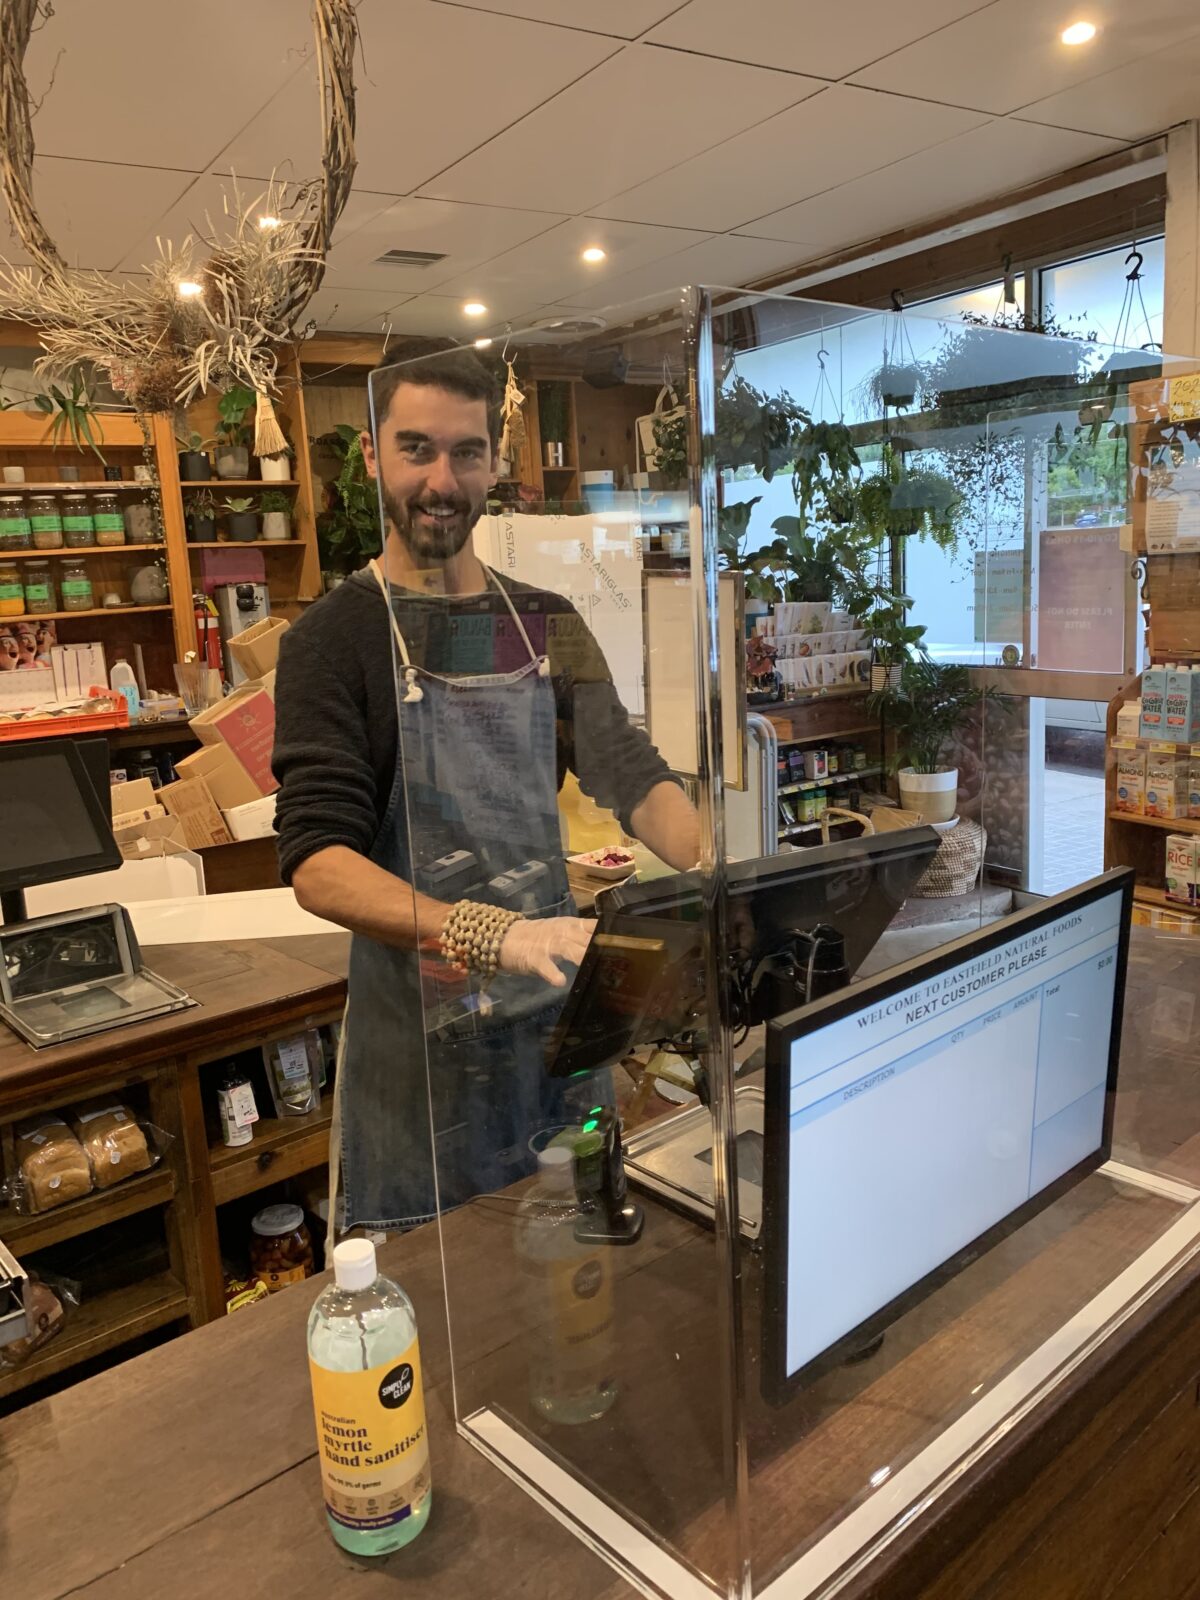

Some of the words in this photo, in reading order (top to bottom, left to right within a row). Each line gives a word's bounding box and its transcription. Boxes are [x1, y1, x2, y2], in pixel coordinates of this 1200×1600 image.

[1142, 703, 1162, 714] WATER
[1167, 706, 1187, 716] WATER
[1118, 767, 1144, 777] ALMOND
[1168, 851, 1193, 867] RICE
[857, 991, 922, 1029] WELCOME
[924, 983, 941, 998] TO
[943, 951, 1003, 990] EASTFIELD
[1004, 932, 1049, 964] NATURAL
[1052, 914, 1083, 939] FOODS
[905, 998, 939, 1024] NEXT
[941, 965, 1006, 1007] CUSTOMER
[1008, 945, 1049, 975] PLEASE
[843, 1065, 896, 1101] DESCRIPTION
[950, 1030, 965, 1045] QTY
[982, 1010, 1002, 1026] PRICE
[1012, 989, 1039, 1010] AMOUNT
[381, 1379, 403, 1397] SIMPLY
[393, 1380, 411, 1399] CLEAN
[321, 1417, 368, 1438] lemon
[323, 1433, 372, 1452] myrtle
[324, 1445, 361, 1467] hand
